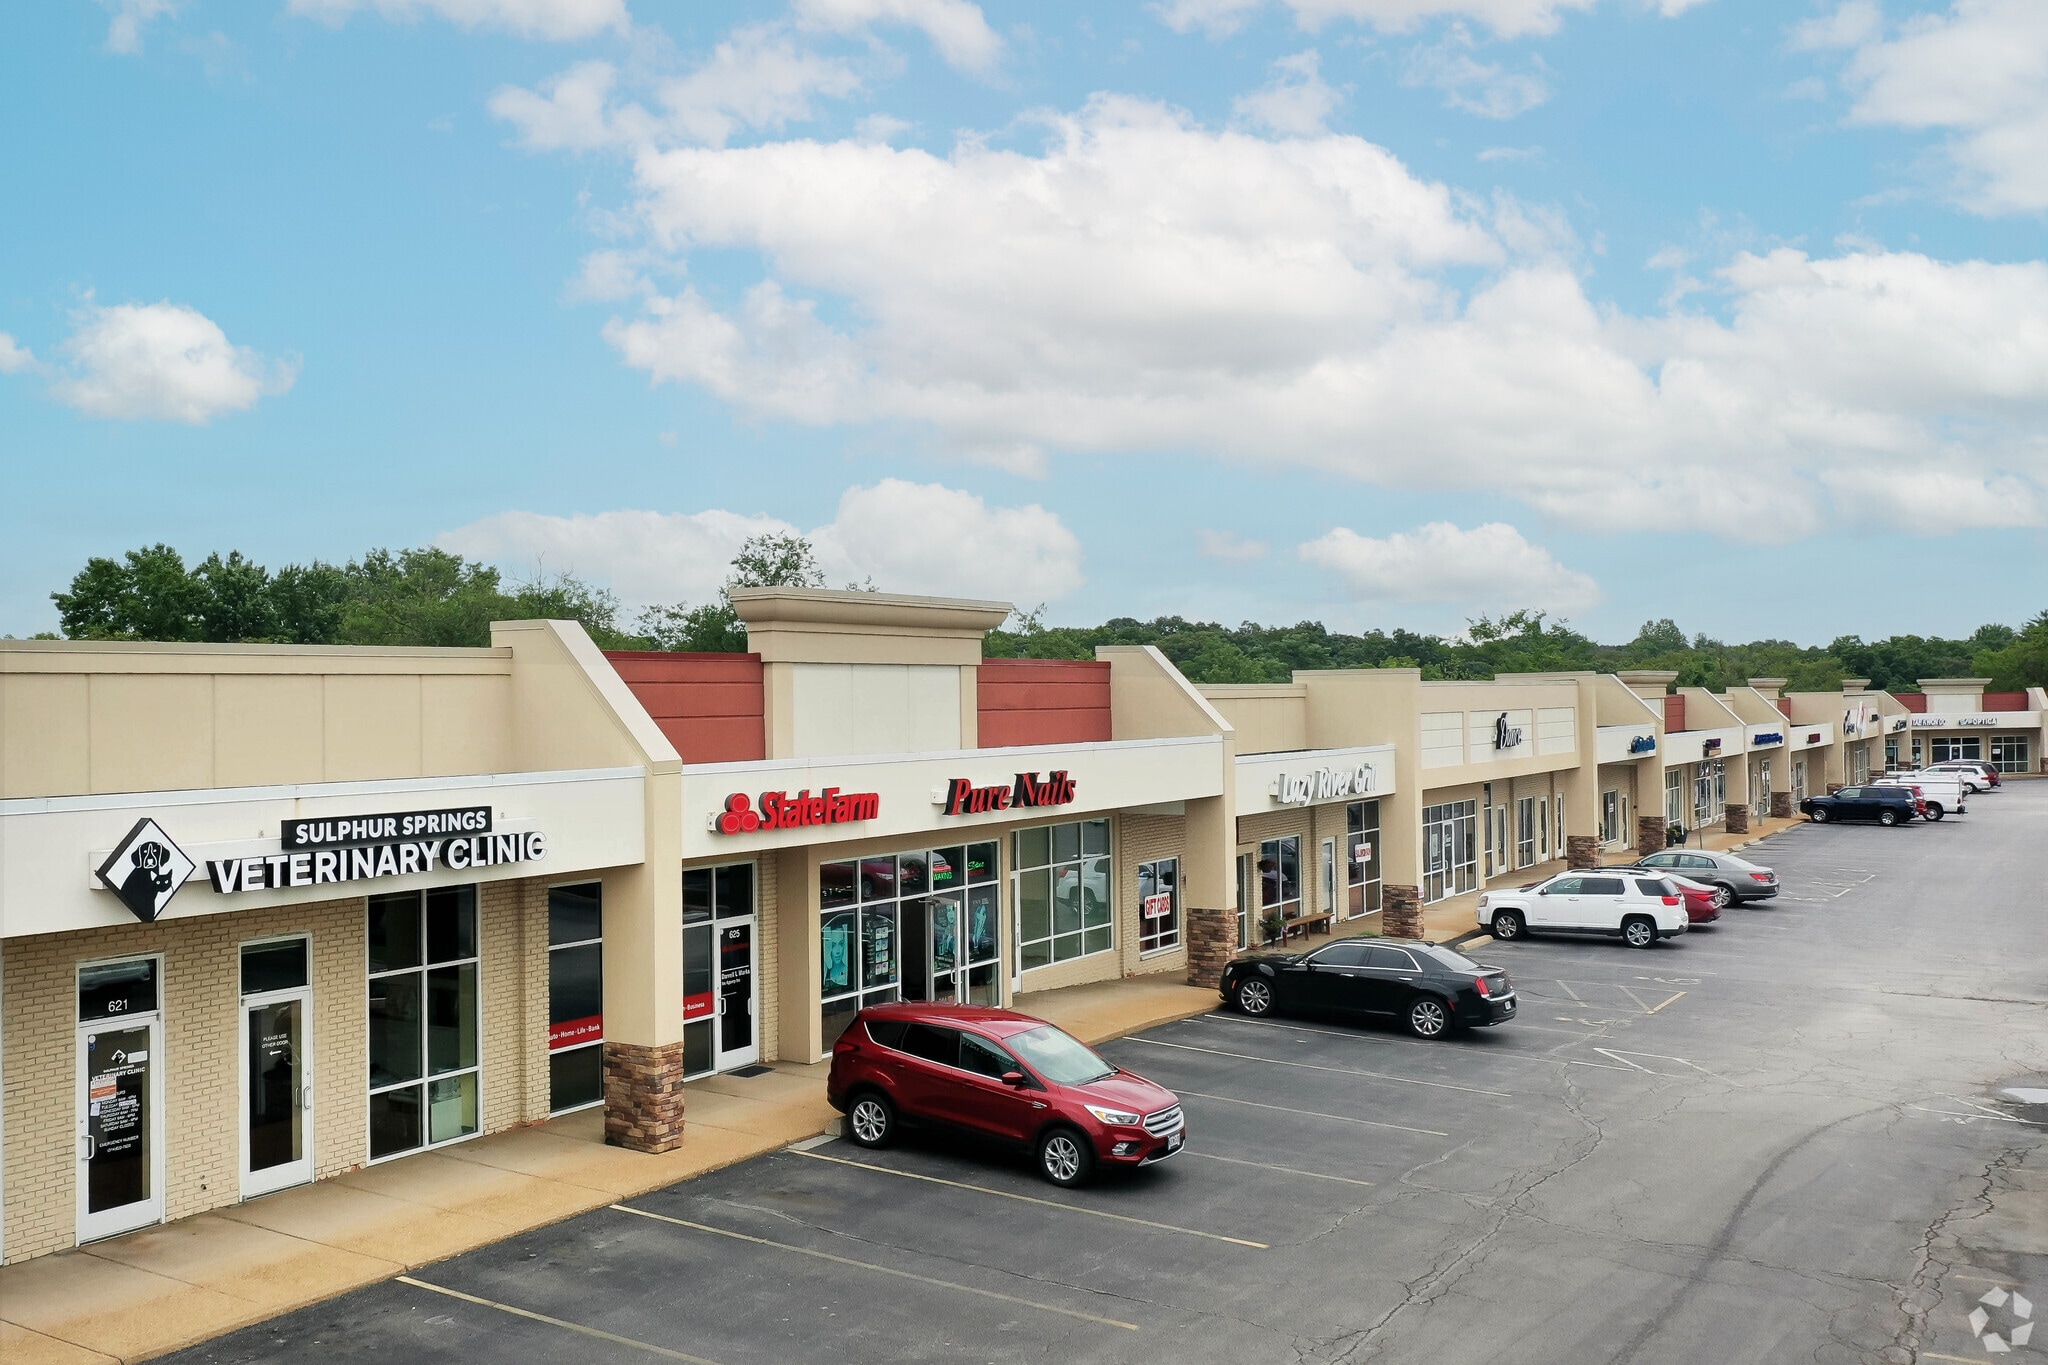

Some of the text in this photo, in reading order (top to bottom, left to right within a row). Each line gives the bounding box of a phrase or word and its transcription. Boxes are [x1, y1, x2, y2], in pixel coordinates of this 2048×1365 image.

[943, 770, 1077, 816] Pure Nails
[1279, 773, 1315, 807] Lazy
[1316, 767, 1353, 799] River
[295, 810, 487, 844] SULPHUR SPRINGS
[208, 831, 548, 894] VETERINARY CLINIC
[1146, 895, 1170, 916] GIFT CARDS
[728, 929, 740, 939] 625
[108, 999, 128, 1013] 621
[560, 1030, 575, 1038] Home
[588, 1023, 600, 1032] Bank
[126, 1067, 146, 1075] CLINIC
